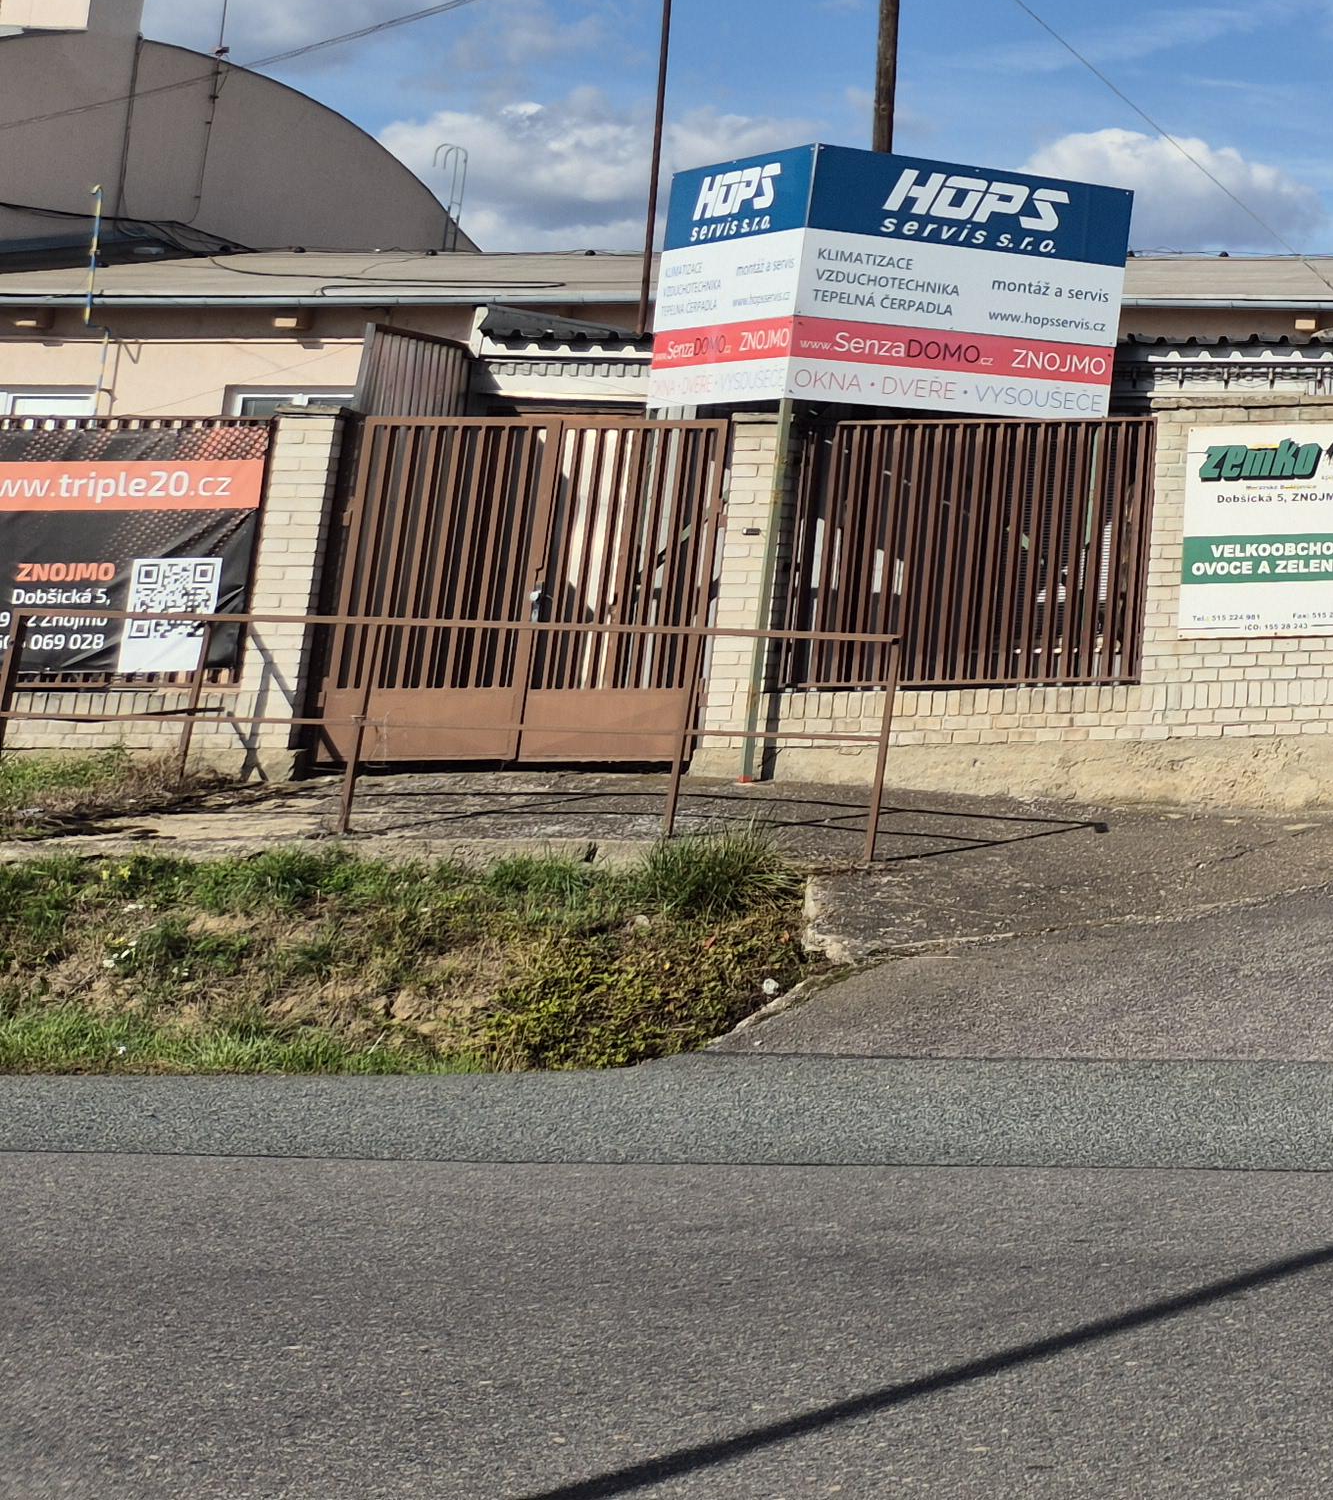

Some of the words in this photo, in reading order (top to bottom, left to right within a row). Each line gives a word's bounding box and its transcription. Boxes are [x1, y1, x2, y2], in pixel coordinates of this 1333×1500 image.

[692, 162, 782, 221] HOPS
[882, 168, 1071, 233] HOPS
[690, 217, 738, 242] servis
[741, 215, 771, 233] s.r.o.
[880, 217, 988, 244] servis
[996, 233, 1056, 254] s.r.o.
[817, 248, 914, 270] KLIMATIZACE
[815, 268, 960, 296] VZDUCHOTECHNIKA
[991, 279, 1050, 296] montáž
[1054, 287, 1063, 298] a
[1067, 288, 1109, 303] servis
[813, 288, 876, 308] TEPELNÁ
[880, 294, 953, 317] ČERPADLA
[988, 310, 1106, 332] www.hopsservis.cz
[739, 328, 790, 352] ZNOJMO
[1011, 348, 1106, 375] ZNOJMO
[794, 368, 862, 392] OKNA
[881, 375, 957, 400] DVEŘE
[975, 383, 1104, 413] VYSOUŠEČE
[1216, 492, 1273, 504] Dobšická
[1277, 493, 1287, 504] 5,
[16, 562, 116, 582] ZNOJMO
[1191, 562, 1253, 575] OVOCE
[1258, 561, 1271, 574] A
[11, 588, 92, 605] Dobšická
[95, 588, 111, 606] 5,
[30, 633, 66, 651] 069
[68, 633, 105, 651] 028
